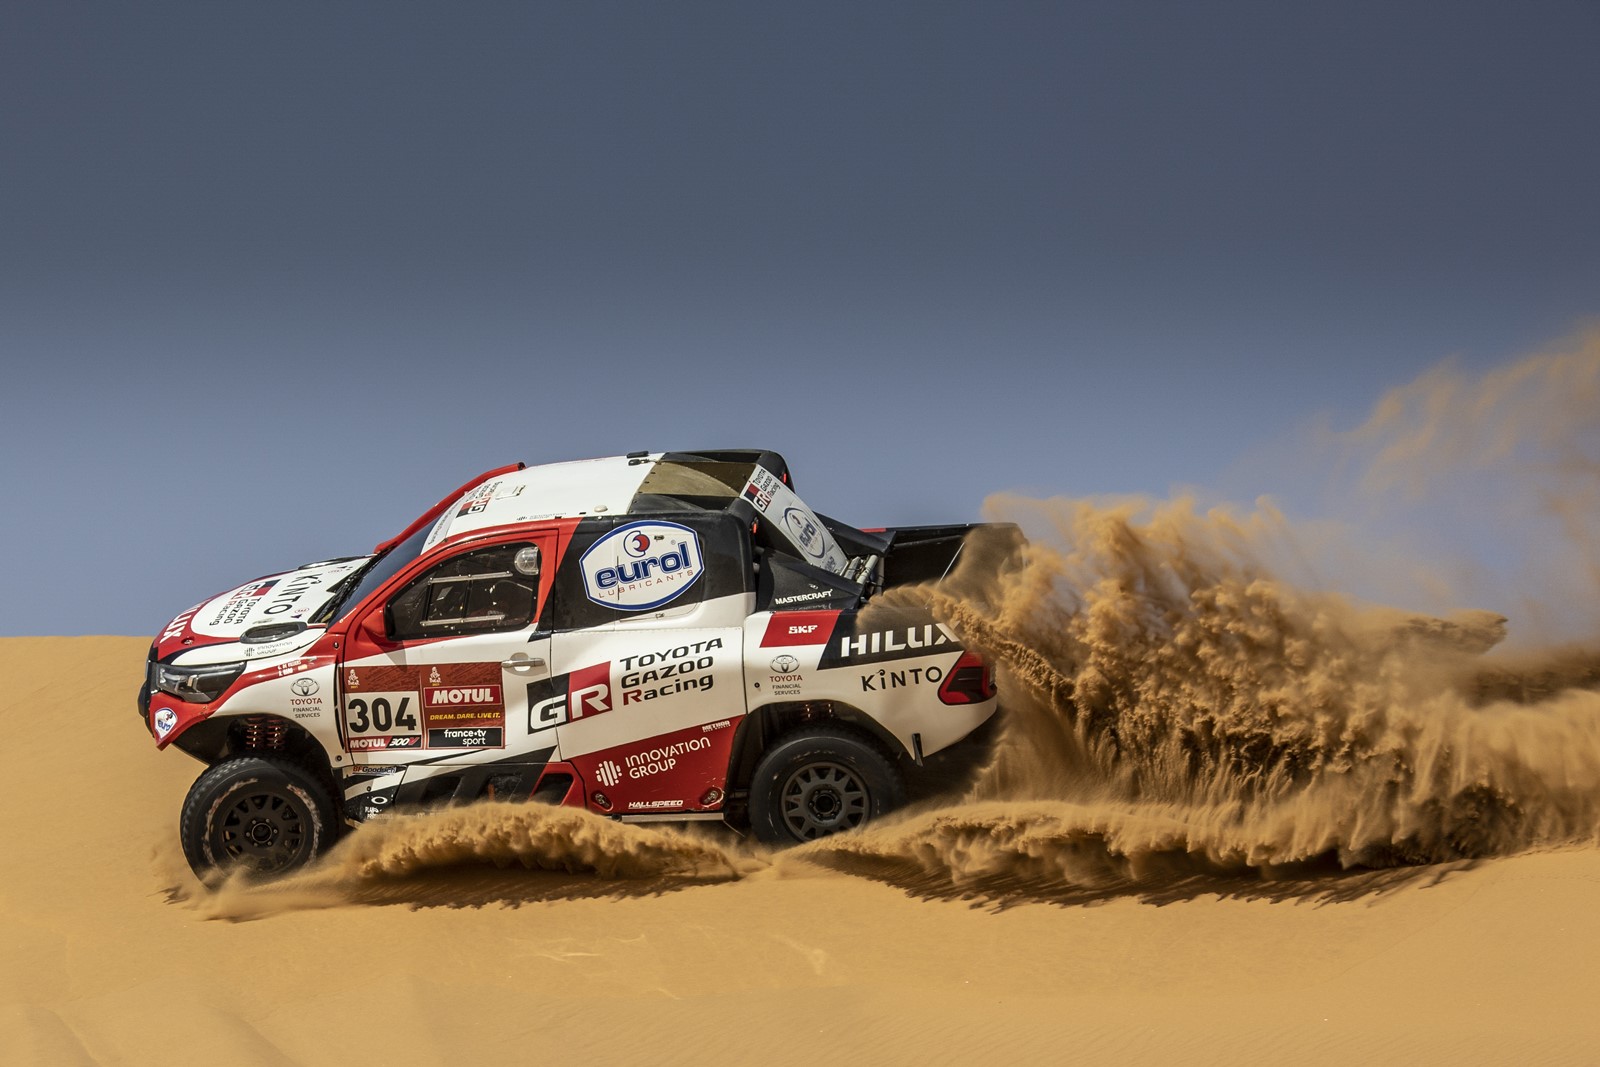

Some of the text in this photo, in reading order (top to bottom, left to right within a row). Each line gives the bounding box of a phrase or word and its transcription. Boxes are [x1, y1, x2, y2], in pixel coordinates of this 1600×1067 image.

[753, 490, 772, 512] GR
[594, 542, 692, 590] eurol
[598, 569, 694, 599] LUBRICANTS
[775, 590, 832, 605] MASTERCRAFT
[209, 600, 238, 626] Racing
[223, 599, 249, 624] GAZOO
[233, 597, 262, 625] TOYOTA
[788, 624, 818, 635] SKF
[841, 621, 961, 658] HILUX
[620, 637, 723, 672] TOYOTA
[621, 655, 714, 689] GAZOO
[769, 674, 803, 683] TOYOTA
[290, 697, 323, 705] TOYOTA
[431, 688, 494, 704] MOTUL
[623, 674, 714, 706] Racing
[348, 697, 417, 733] 304
[430, 713, 456, 721] DREAM.
[457, 712, 476, 720] DARE.
[530, 682, 611, 730] GR
[350, 736, 420, 749] MOTUL 300V
[462, 737, 486, 747] sport
[625, 736, 711, 768] INNOVATION
[352, 766, 397, 774] BFGoodrich
[629, 758, 677, 780] GROUP
[628, 799, 684, 810] HALLSPEED
